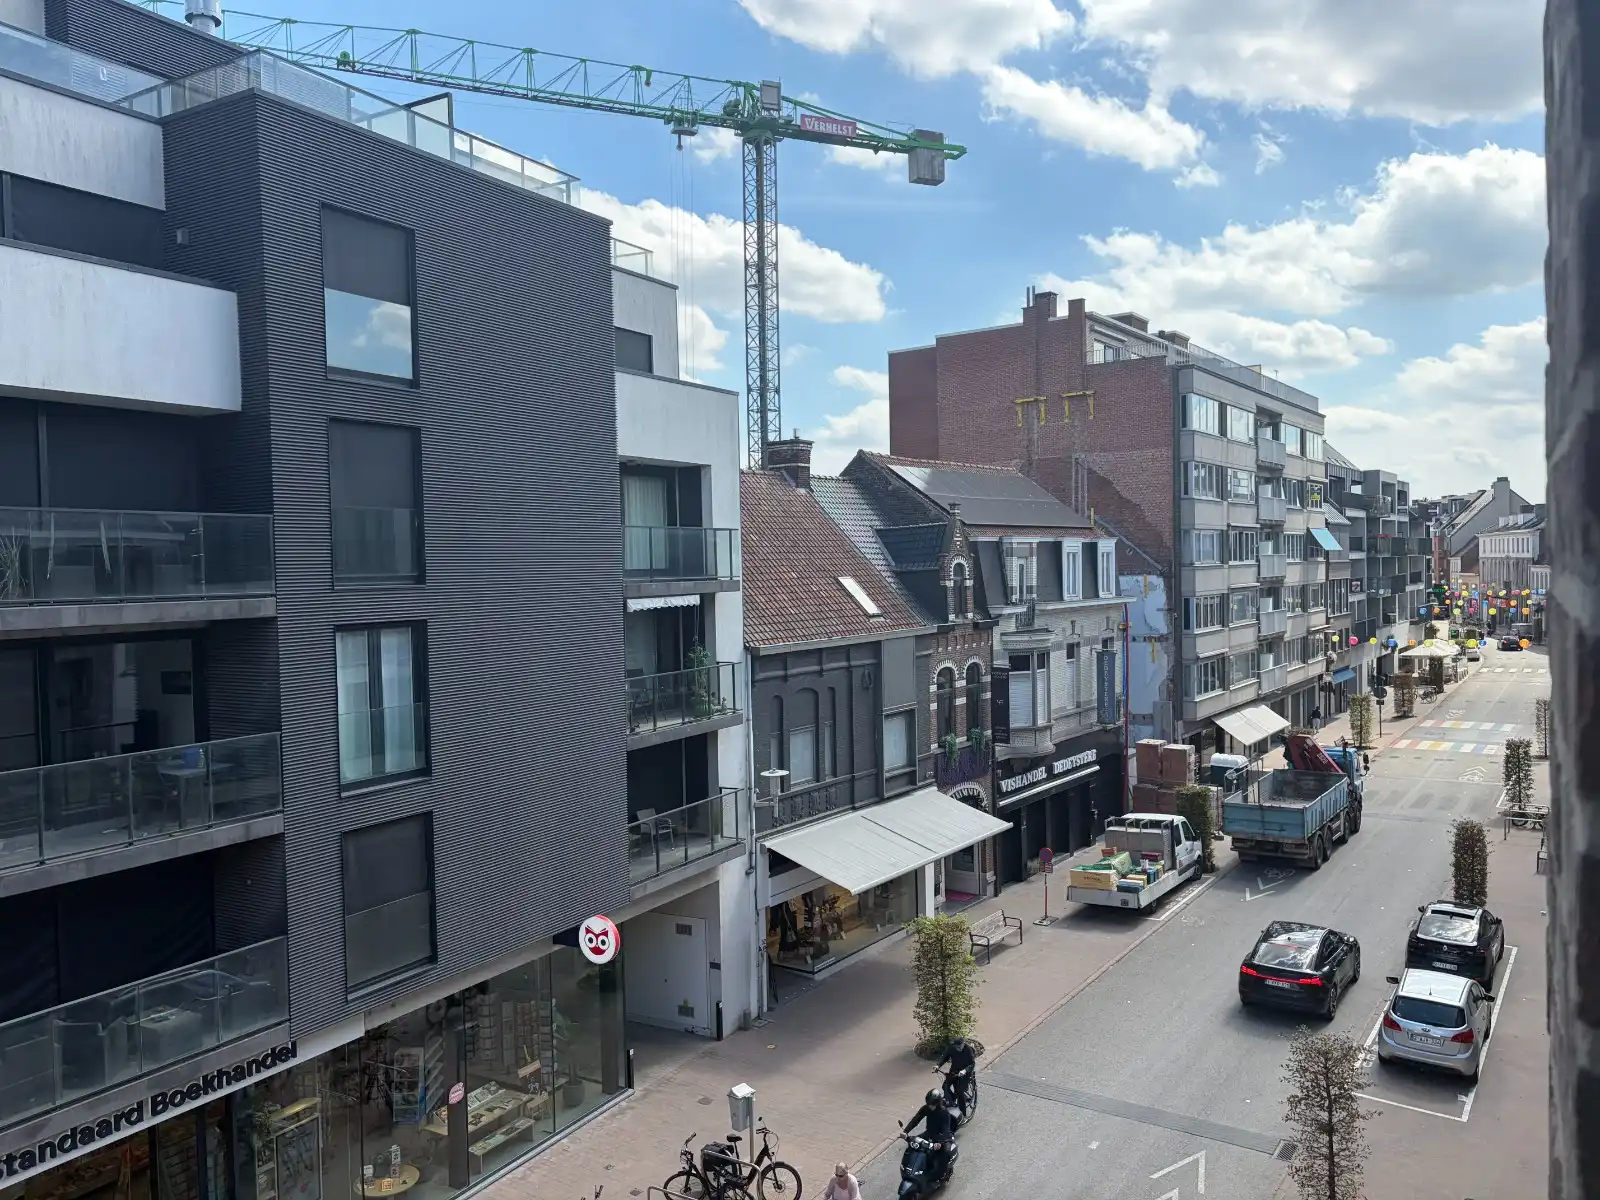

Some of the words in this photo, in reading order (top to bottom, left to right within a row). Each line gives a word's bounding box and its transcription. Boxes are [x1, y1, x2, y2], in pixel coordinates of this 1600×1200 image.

[804, 117, 853, 136] VERHELST
[1000, 766, 1048, 793] VISHANDEL
[1052, 749, 1097, 774] DEDEYSTERE
[150, 1041, 298, 1117] Boekhandel
